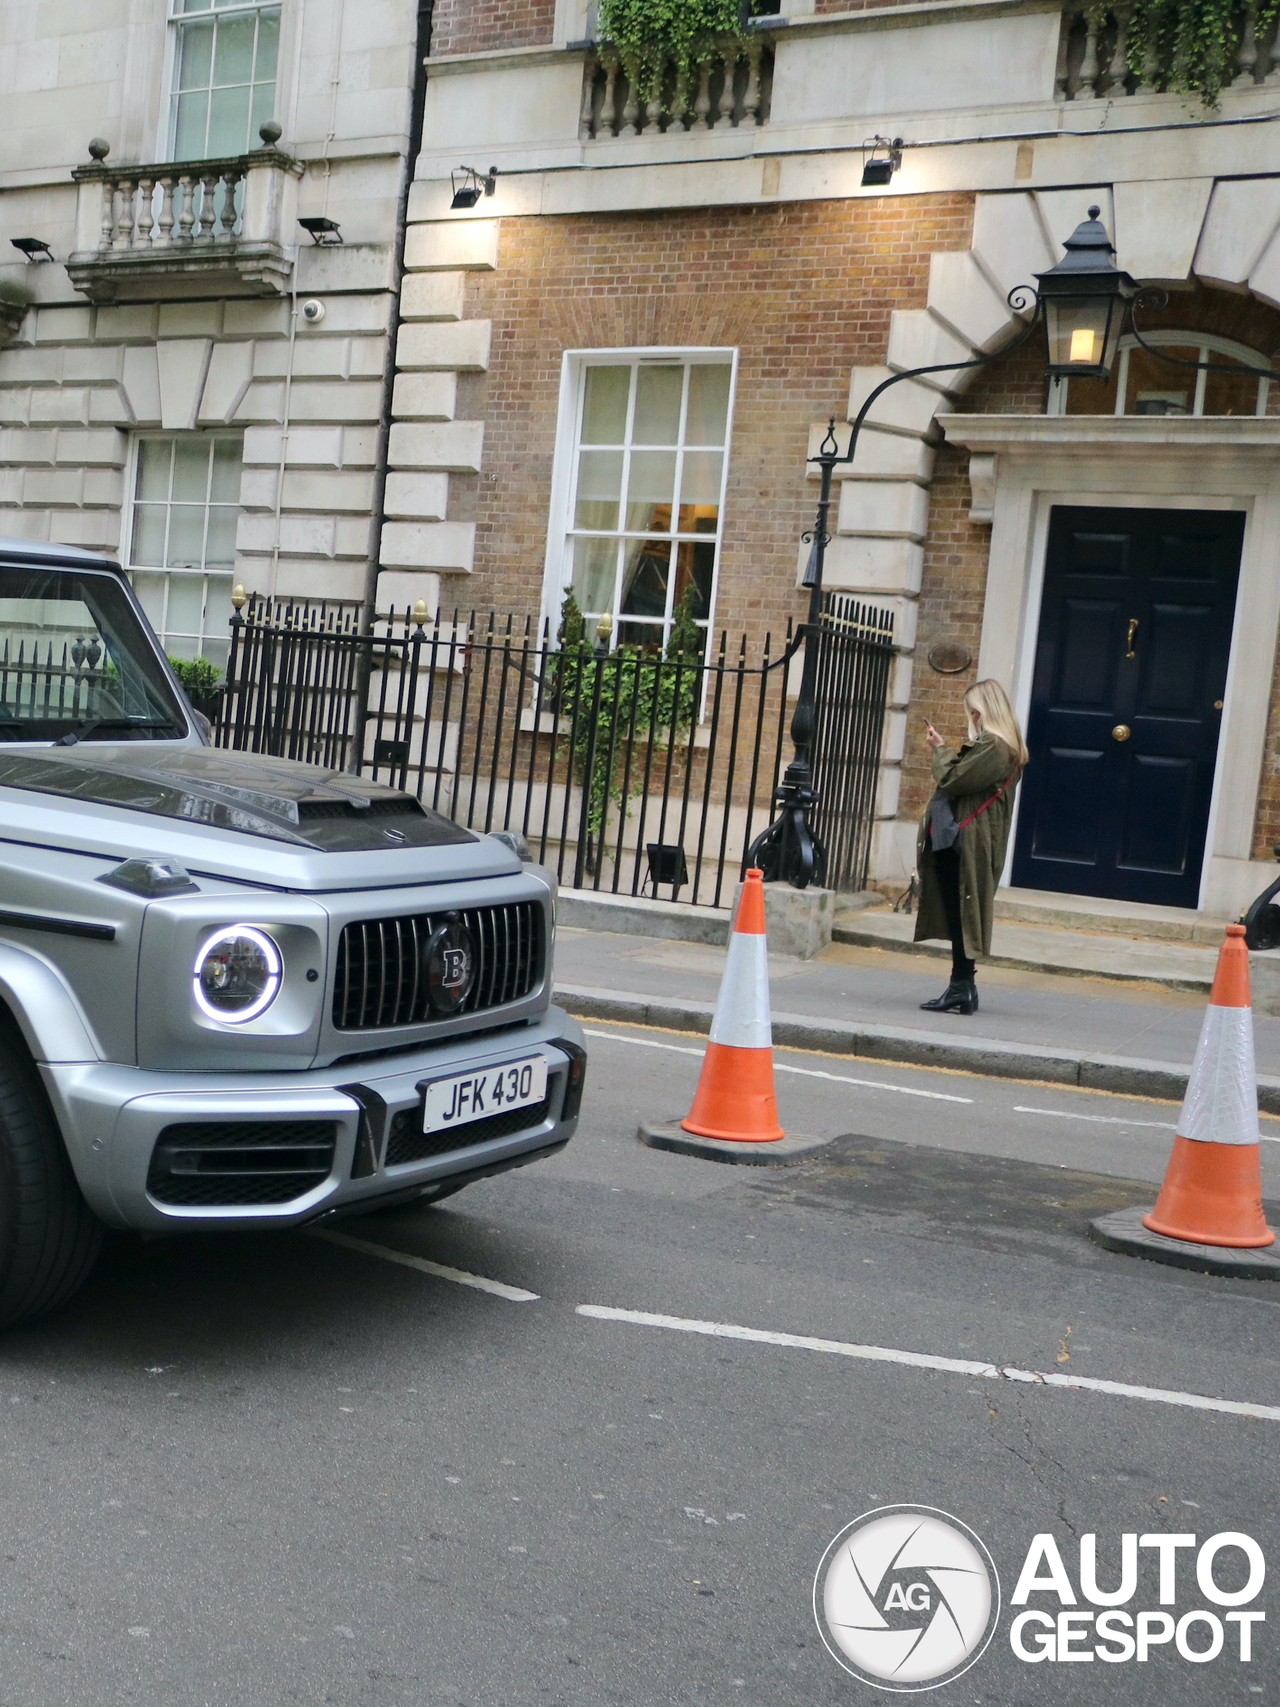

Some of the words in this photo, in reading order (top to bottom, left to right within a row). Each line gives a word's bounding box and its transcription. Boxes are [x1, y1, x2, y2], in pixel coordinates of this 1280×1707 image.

[442, 948, 467, 988] B
[442, 1076, 487, 1121] JFK
[492, 1064, 533, 1107] 430
